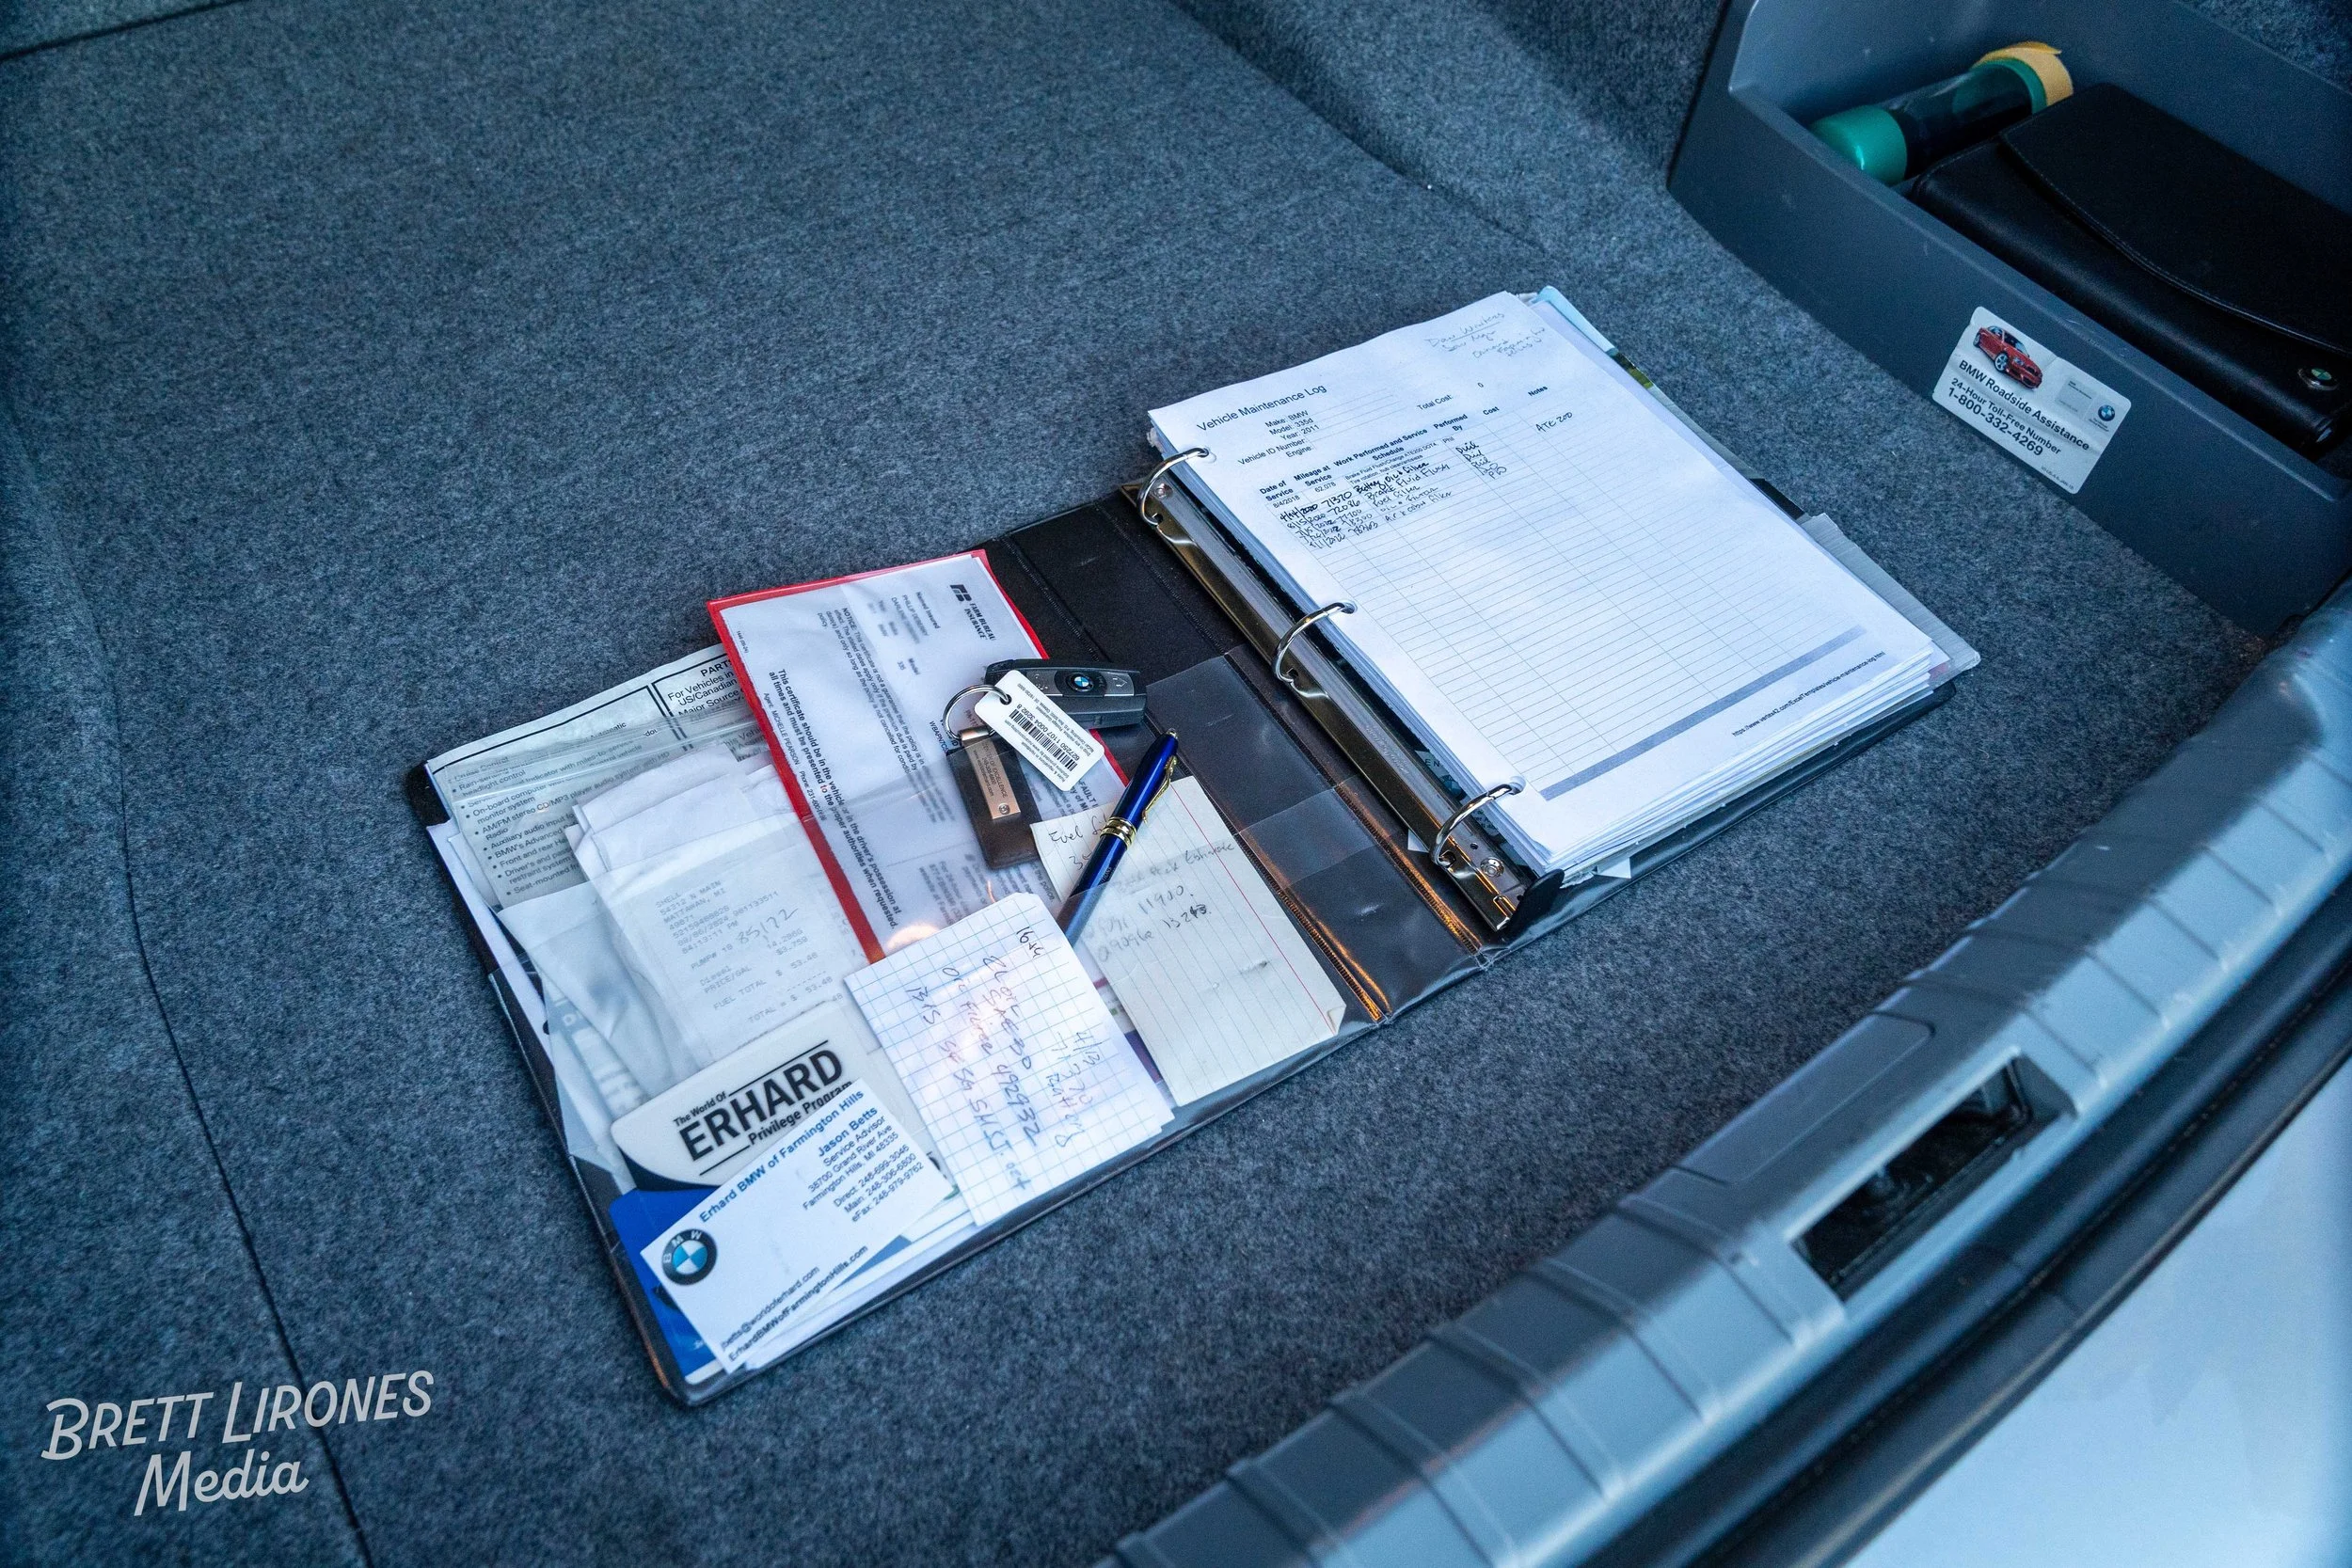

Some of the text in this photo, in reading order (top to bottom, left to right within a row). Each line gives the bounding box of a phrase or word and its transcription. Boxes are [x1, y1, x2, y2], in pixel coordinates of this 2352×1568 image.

[1196, 386, 1327, 431] Vehicle Maintenance Log
[1417, 394, 1454, 410] Total Cost:
[1951, 377, 2061, 454] 24-Hour Toll-Free Number
[1959, 359, 1986, 383] BMW
[1985, 377, 2032, 414] Roadside
[2032, 410, 2090, 451] Assistance
[1264, 410, 1308, 428] Make: BMW
[1269, 418, 1313, 436] Model: 335d
[1280, 424, 1319, 441] Year: 2011
[1948, 388, 2043, 456] 1-800-332-4269
[1237, 451, 1265, 465] Vehicle
[1276, 438, 1306, 451] Number:
[1260, 485, 1278, 495] Date
[1294, 469, 1318, 482] Mileage
[1334, 456, 1353, 467] Work
[1353, 442, 1389, 460] Performed
[1389, 437, 1402, 446] and
[1402, 429, 1428, 441] Service
[1433, 414, 1468, 430] Performed
[1483, 406, 1500, 416] Cost
[1528, 386, 1548, 397] Notes
[1286, 446, 1313, 458] Engine:
[1265, 488, 1294, 501] Service
[1305, 474, 1332, 487] Service
[1373, 447, 1405, 461] Schedule
[842, 608, 857, 630] NOTICE:
[964, 609, 986, 638] INSURANCE
[969, 603, 995, 640] FARM BUREAU
[667, 690, 684, 701] For
[684, 675, 724, 693] Vehicles
[677, 679, 738, 706] US/Canadian
[706, 690, 739, 707] Source
[1021, 707, 1035, 721] 3292
[881, 719, 901, 753] cancelled for
[901, 725, 911, 735] the
[905, 736, 919, 752] policy
[1046, 732, 1061, 743] 1107
[783, 737, 800, 765] PEARSON
[903, 750, 914, 763] paid
[911, 763, 918, 771] by
[505, 768, 526, 782] control
[769, 672, 898, 929] all times and must be presented to the proper authorities when requested.
[778, 668, 901, 914] This certificate should be in the vehicle the driver's possession at
[472, 797, 510, 816] On-board
[477, 796, 536, 825] monitor system
[483, 794, 569, 833] AM/FM stereo CD/MP3
[485, 828, 508, 841] Radio
[491, 816, 565, 849] Auxiliary audio input
[494, 843, 524, 858] BMW's
[500, 848, 537, 867] Front and
[504, 862, 534, 877] Driver's
[514, 865, 570, 894] Seat-mounted
[674, 1091, 726, 1127] The World Of
[679, 1050, 843, 1161] ERHARD
[748, 1111, 802, 1146] Privilege
[818, 1107, 878, 1157] Jason Betts
[822, 1116, 886, 1167] Service Advisor
[699, 1091, 864, 1223] Erhard BMW of Farmington Hills
[832, 1151, 858, 1173] Grand
[855, 1136, 877, 1155] River
[877, 1125, 893, 1139] Ave
[803, 1175, 847, 1211] Farmington
[864, 1149, 876, 1161] MI
[876, 1131, 899, 1152] 48335
